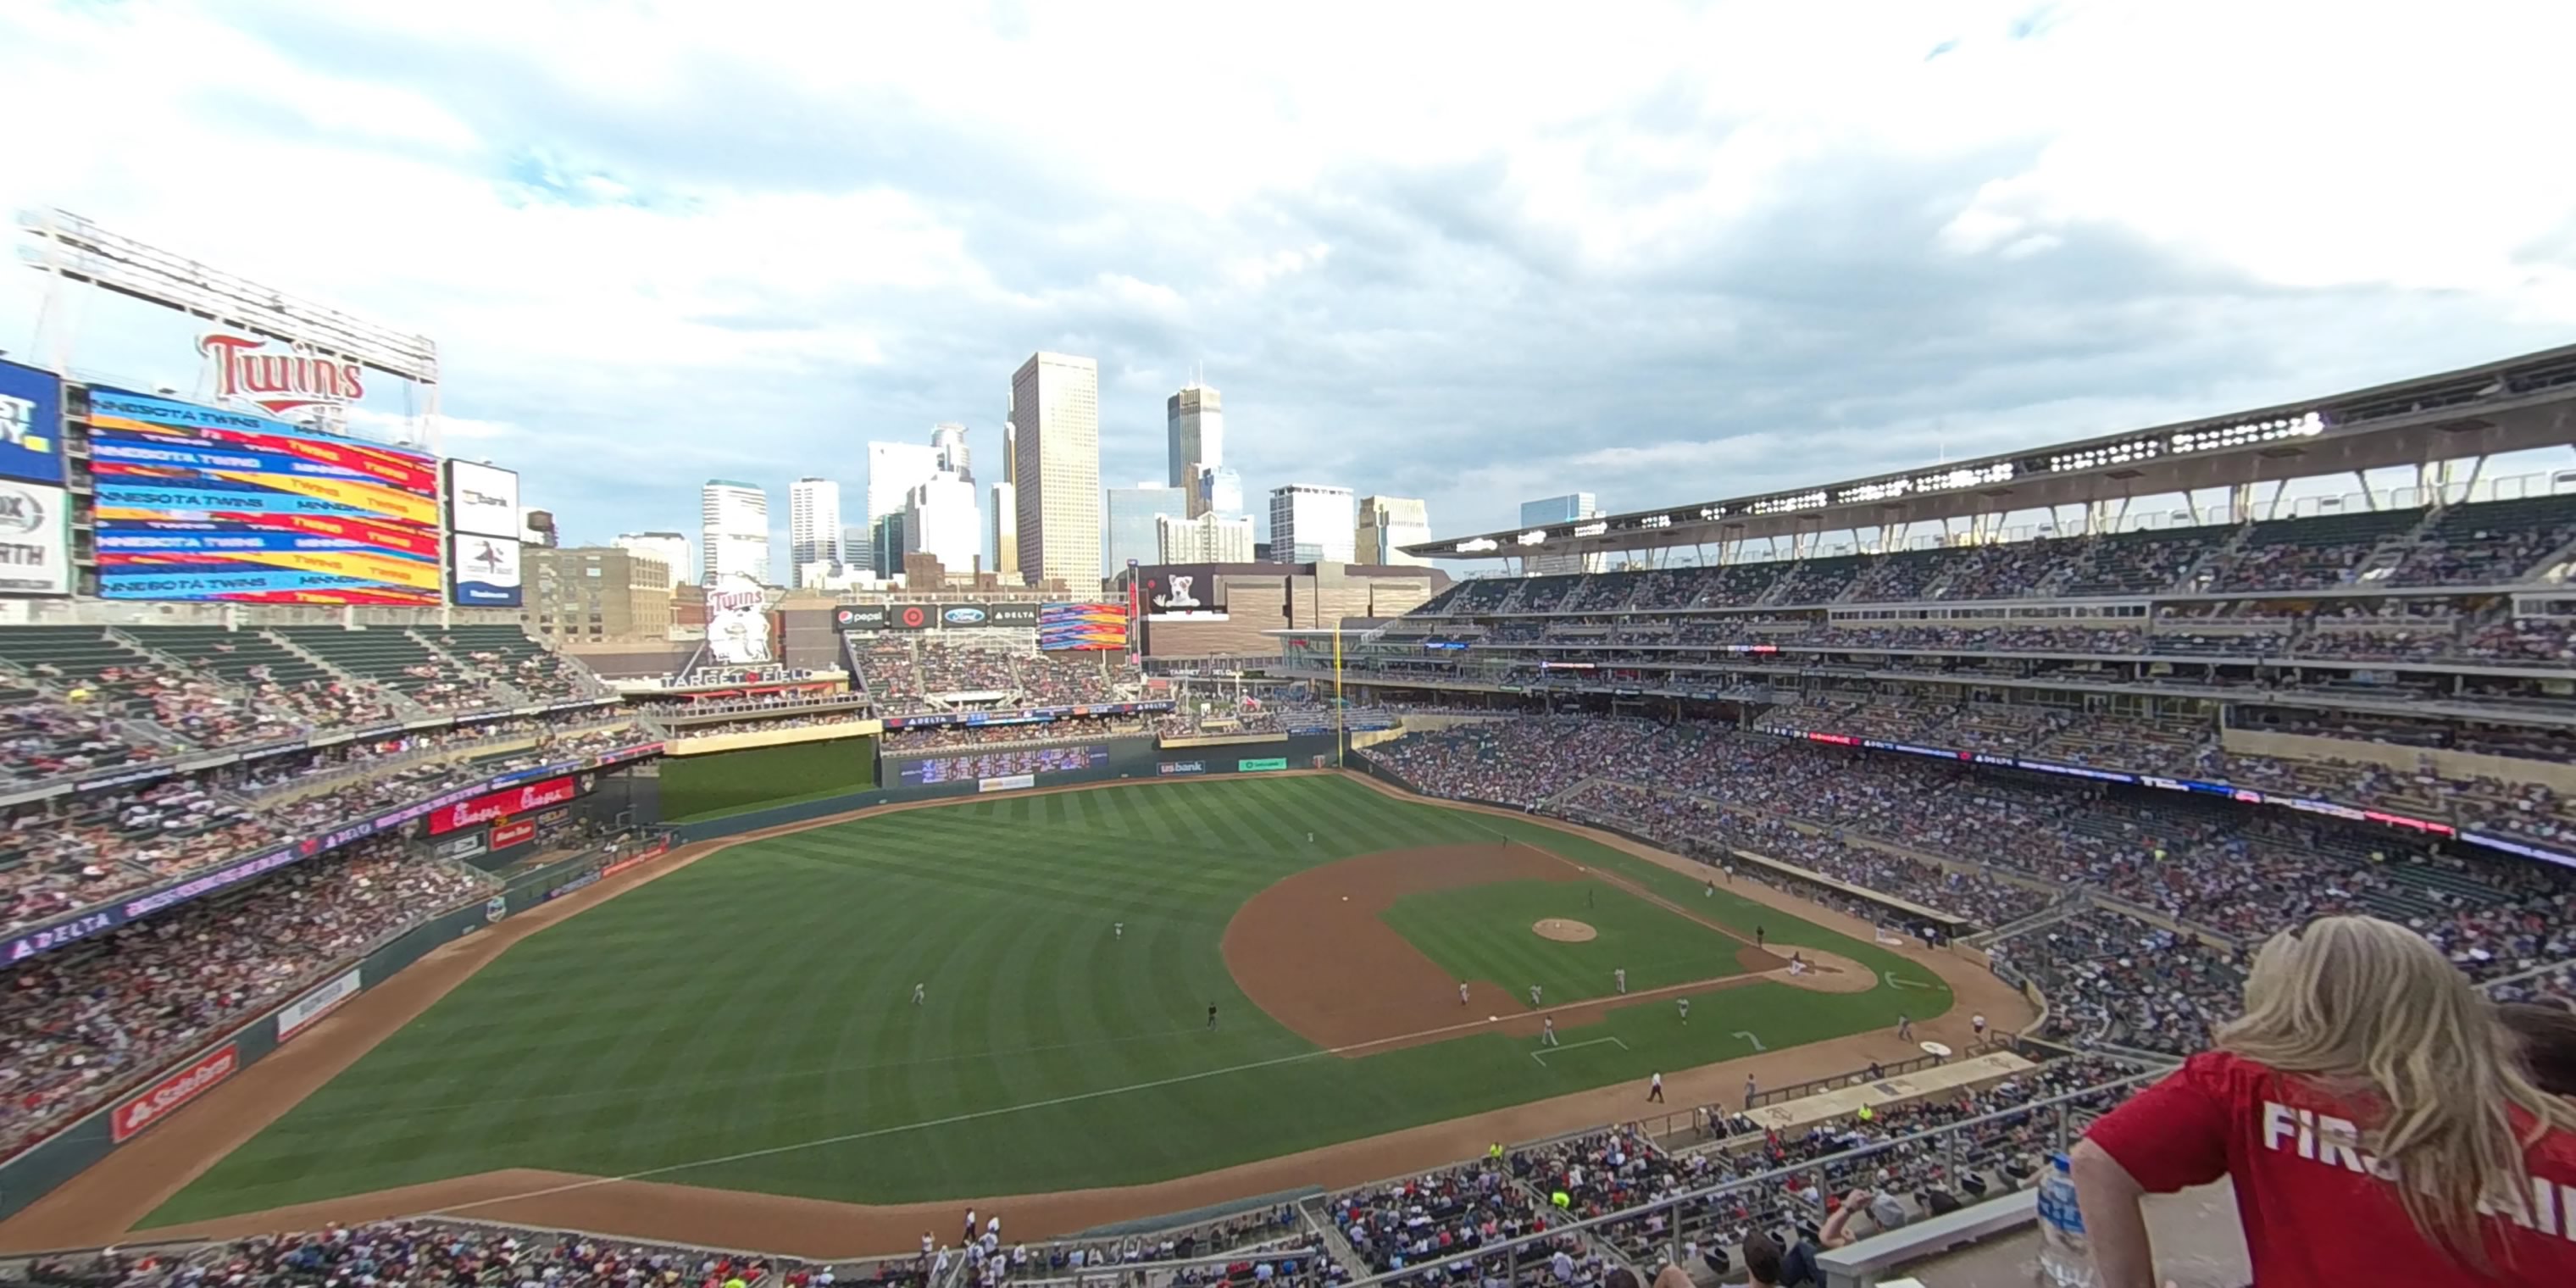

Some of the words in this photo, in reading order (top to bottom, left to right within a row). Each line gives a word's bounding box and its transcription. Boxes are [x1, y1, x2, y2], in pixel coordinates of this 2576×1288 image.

[202, 334, 364, 400] Twins
[200, 412, 260, 428] TWINS
[203, 495, 264, 508] TWINS
[208, 578, 267, 589] TWINS
[710, 591, 763, 612] Twins
[854, 611, 883, 623] pepsi
[1003, 611, 1035, 619] DELTA
[661, 671, 743, 688] TARGET
[762, 668, 813, 683] FIELD
[918, 716, 947, 724] DELTA
[1160, 764, 1174, 774] us
[1174, 762, 1203, 772] bank
[34, 913, 110, 948] DELTA
